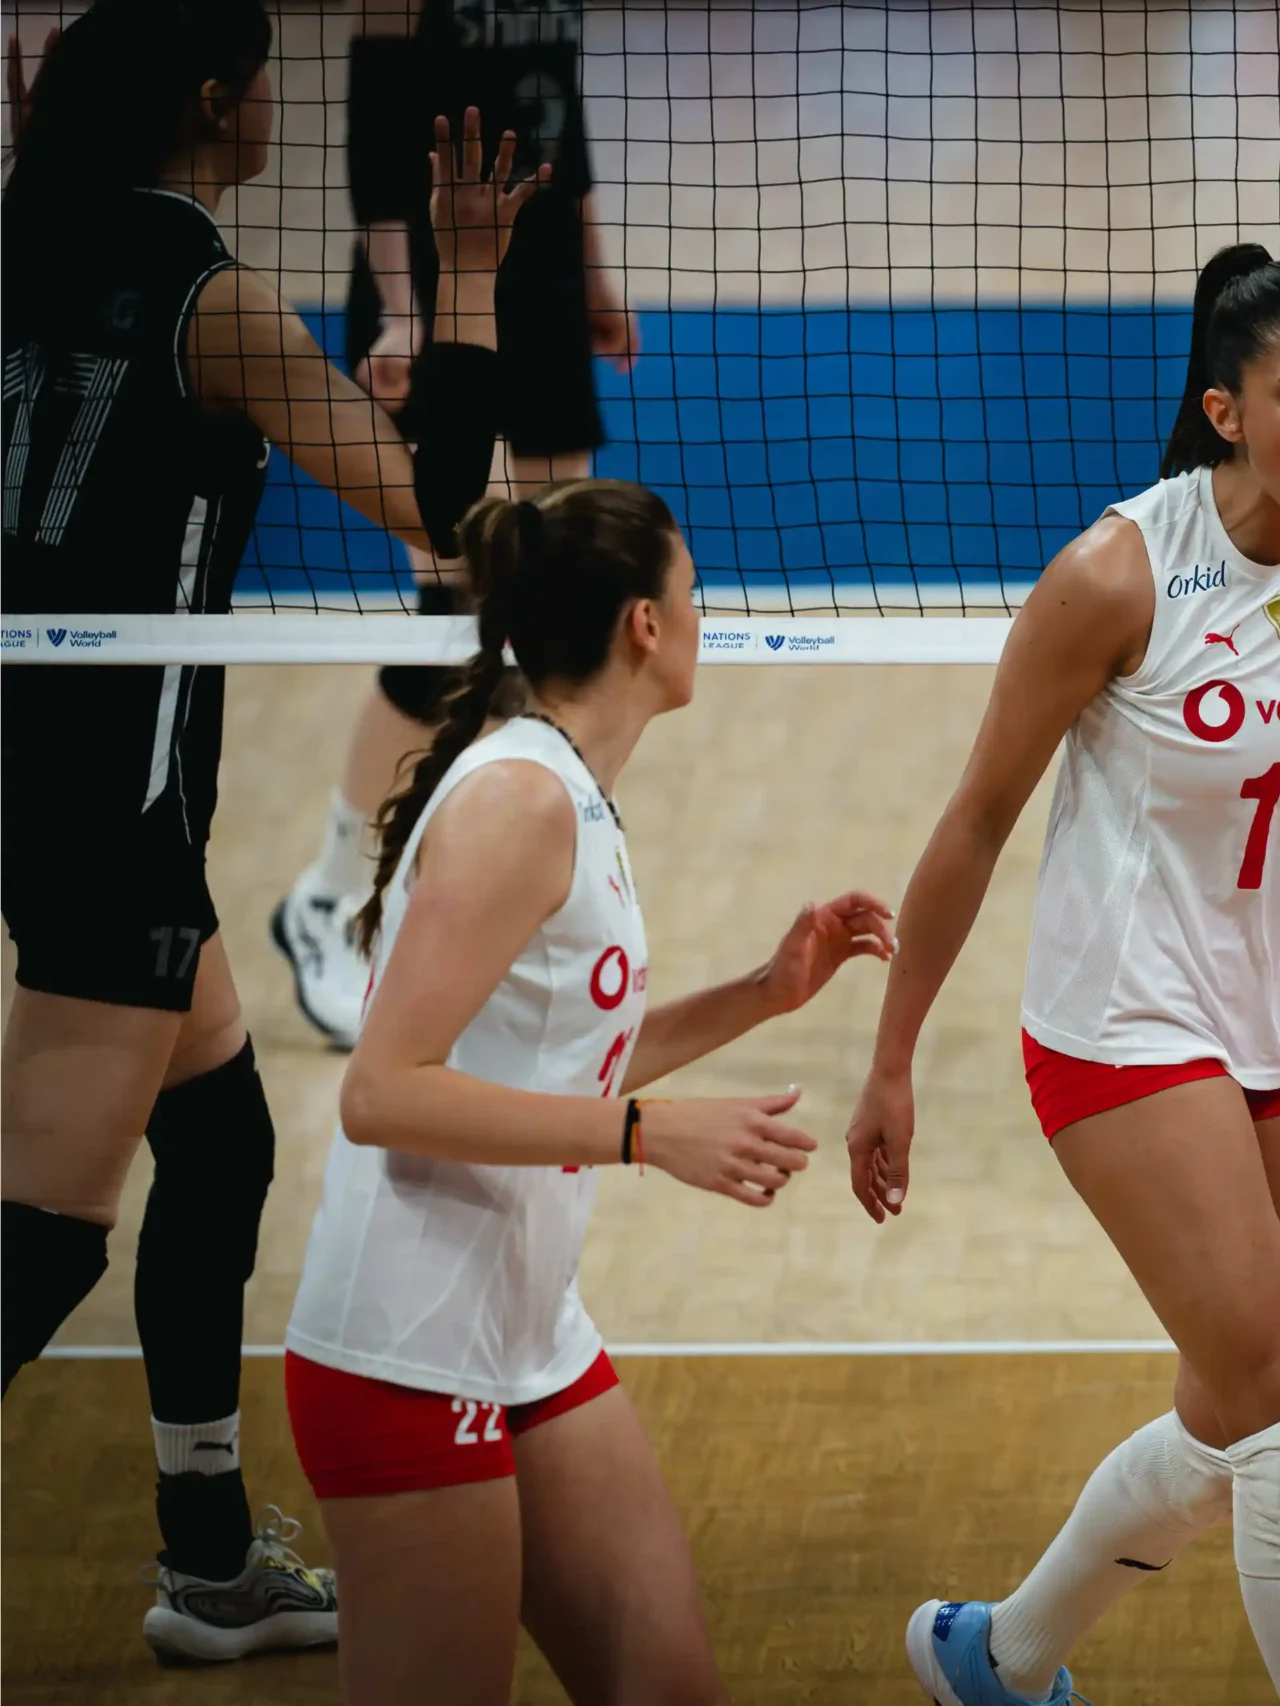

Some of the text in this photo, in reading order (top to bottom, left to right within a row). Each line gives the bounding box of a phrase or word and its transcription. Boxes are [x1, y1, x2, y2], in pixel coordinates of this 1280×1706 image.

[1167, 560, 1227, 599] Orkid
[1, 629, 32, 639] TIONS
[70, 630, 117, 640] Volleyball
[703, 632, 751, 641] NATIONS
[70, 639, 101, 648] World
[788, 636, 835, 646] Volleyball
[148, 926, 201, 979] 17
[451, 1398, 503, 1445] 22
